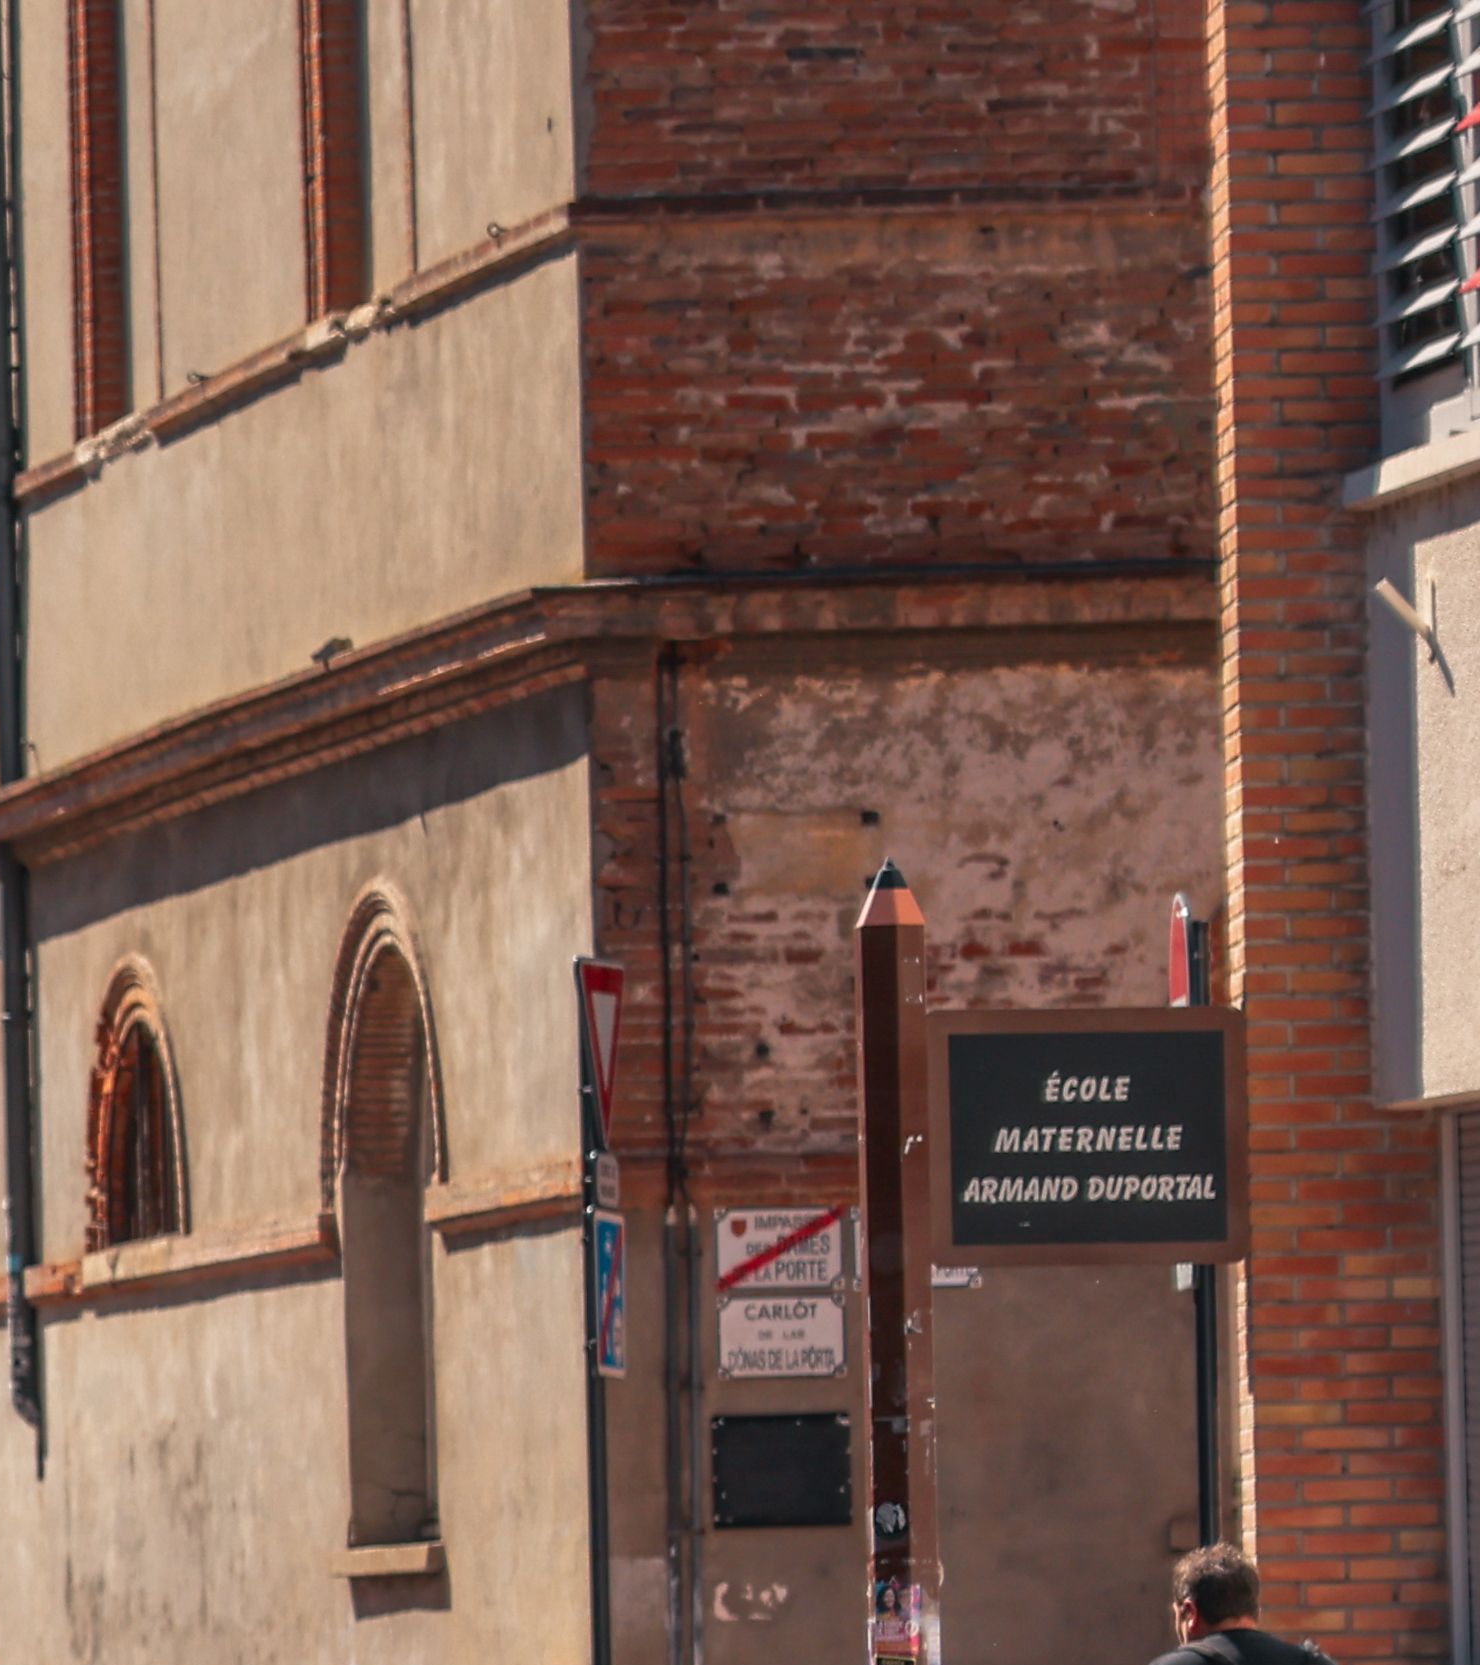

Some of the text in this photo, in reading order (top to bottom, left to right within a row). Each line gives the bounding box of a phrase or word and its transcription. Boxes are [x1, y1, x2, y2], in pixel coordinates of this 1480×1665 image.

[1044, 1070, 1132, 1103] ÉCOLE
[993, 1125, 1183, 1154] MATERNELLE
[963, 1174, 1217, 1204] ARMAND DUPORTAL
[775, 1260, 827, 1281] PORTE
